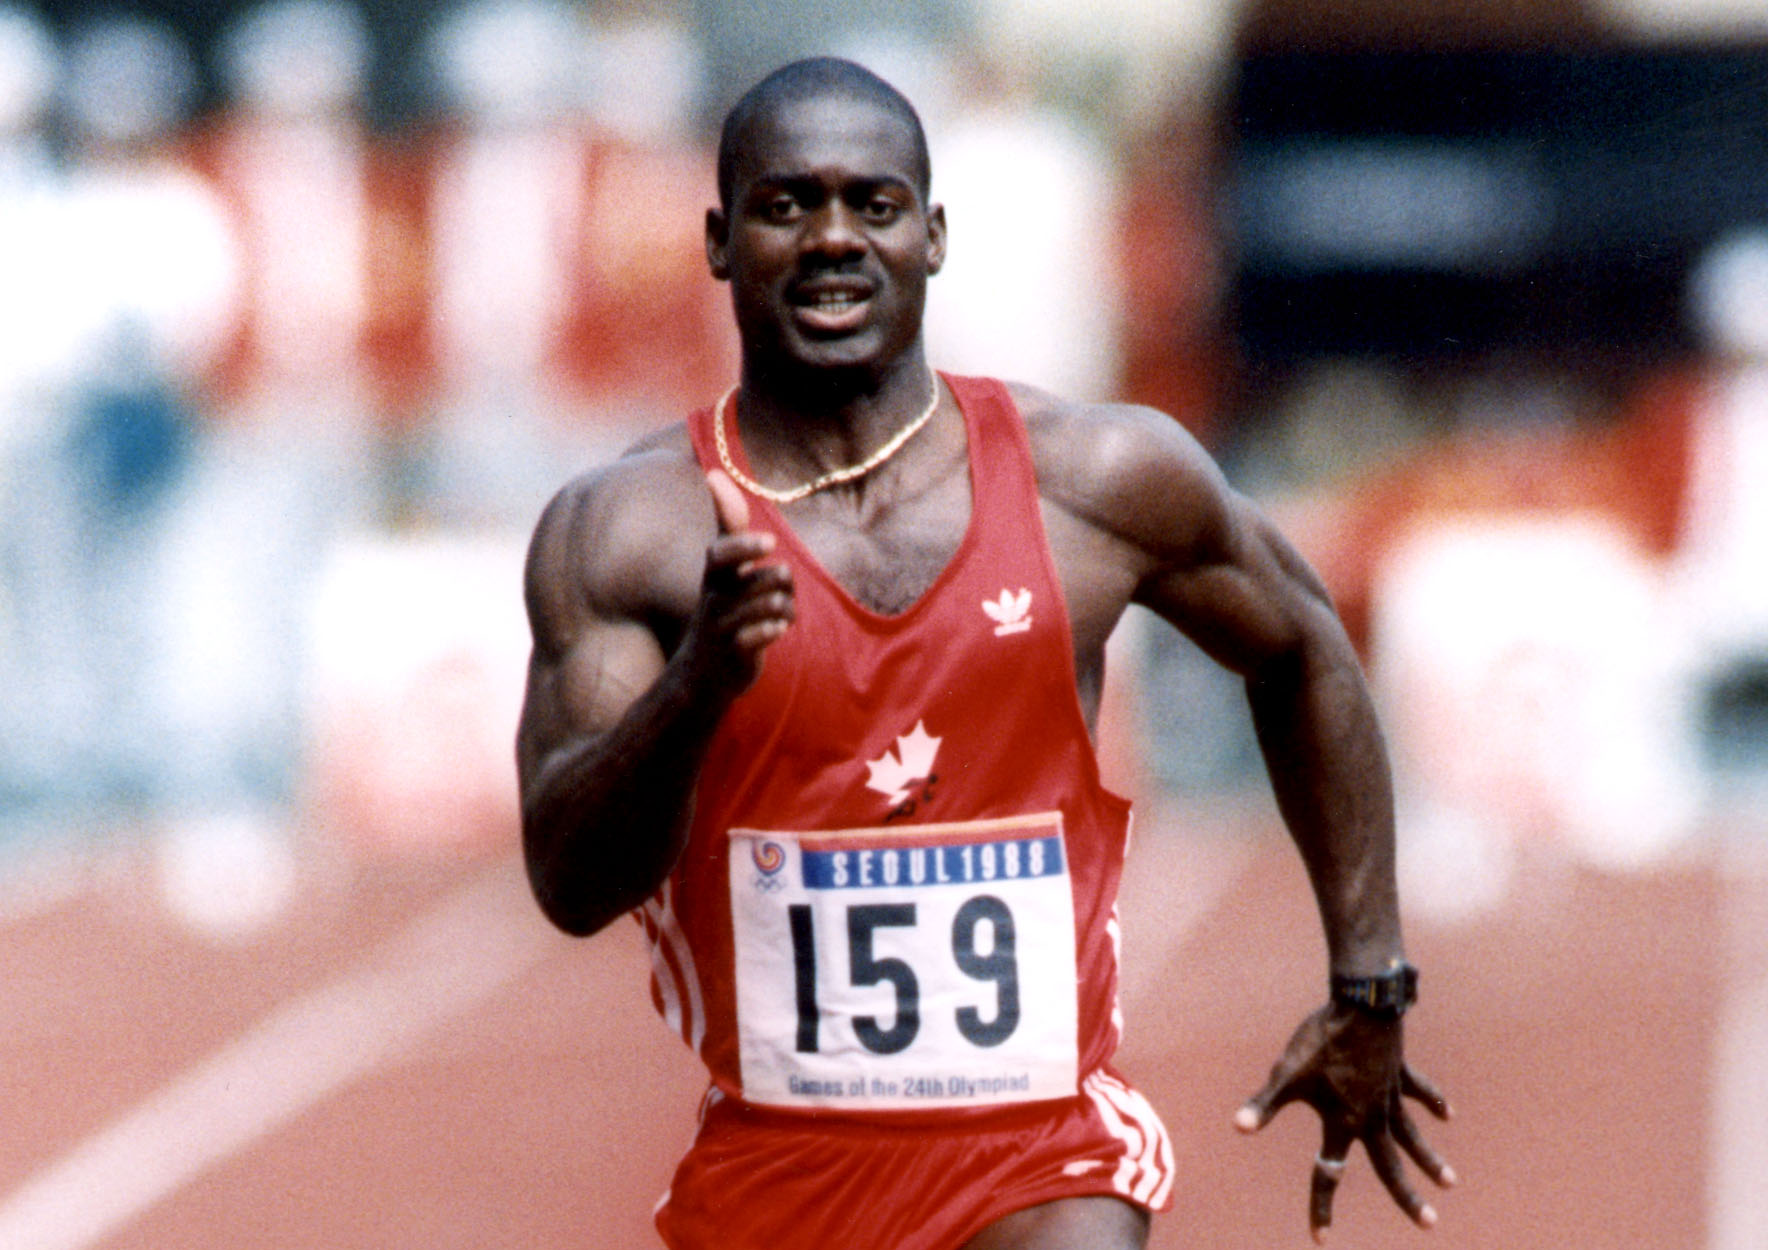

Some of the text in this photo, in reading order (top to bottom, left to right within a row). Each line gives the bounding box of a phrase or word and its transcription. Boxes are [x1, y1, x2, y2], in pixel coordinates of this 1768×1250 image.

[788, 894, 1021, 1054] 159
[789, 1072, 1028, 1097] Games of the 24th Olympiad
